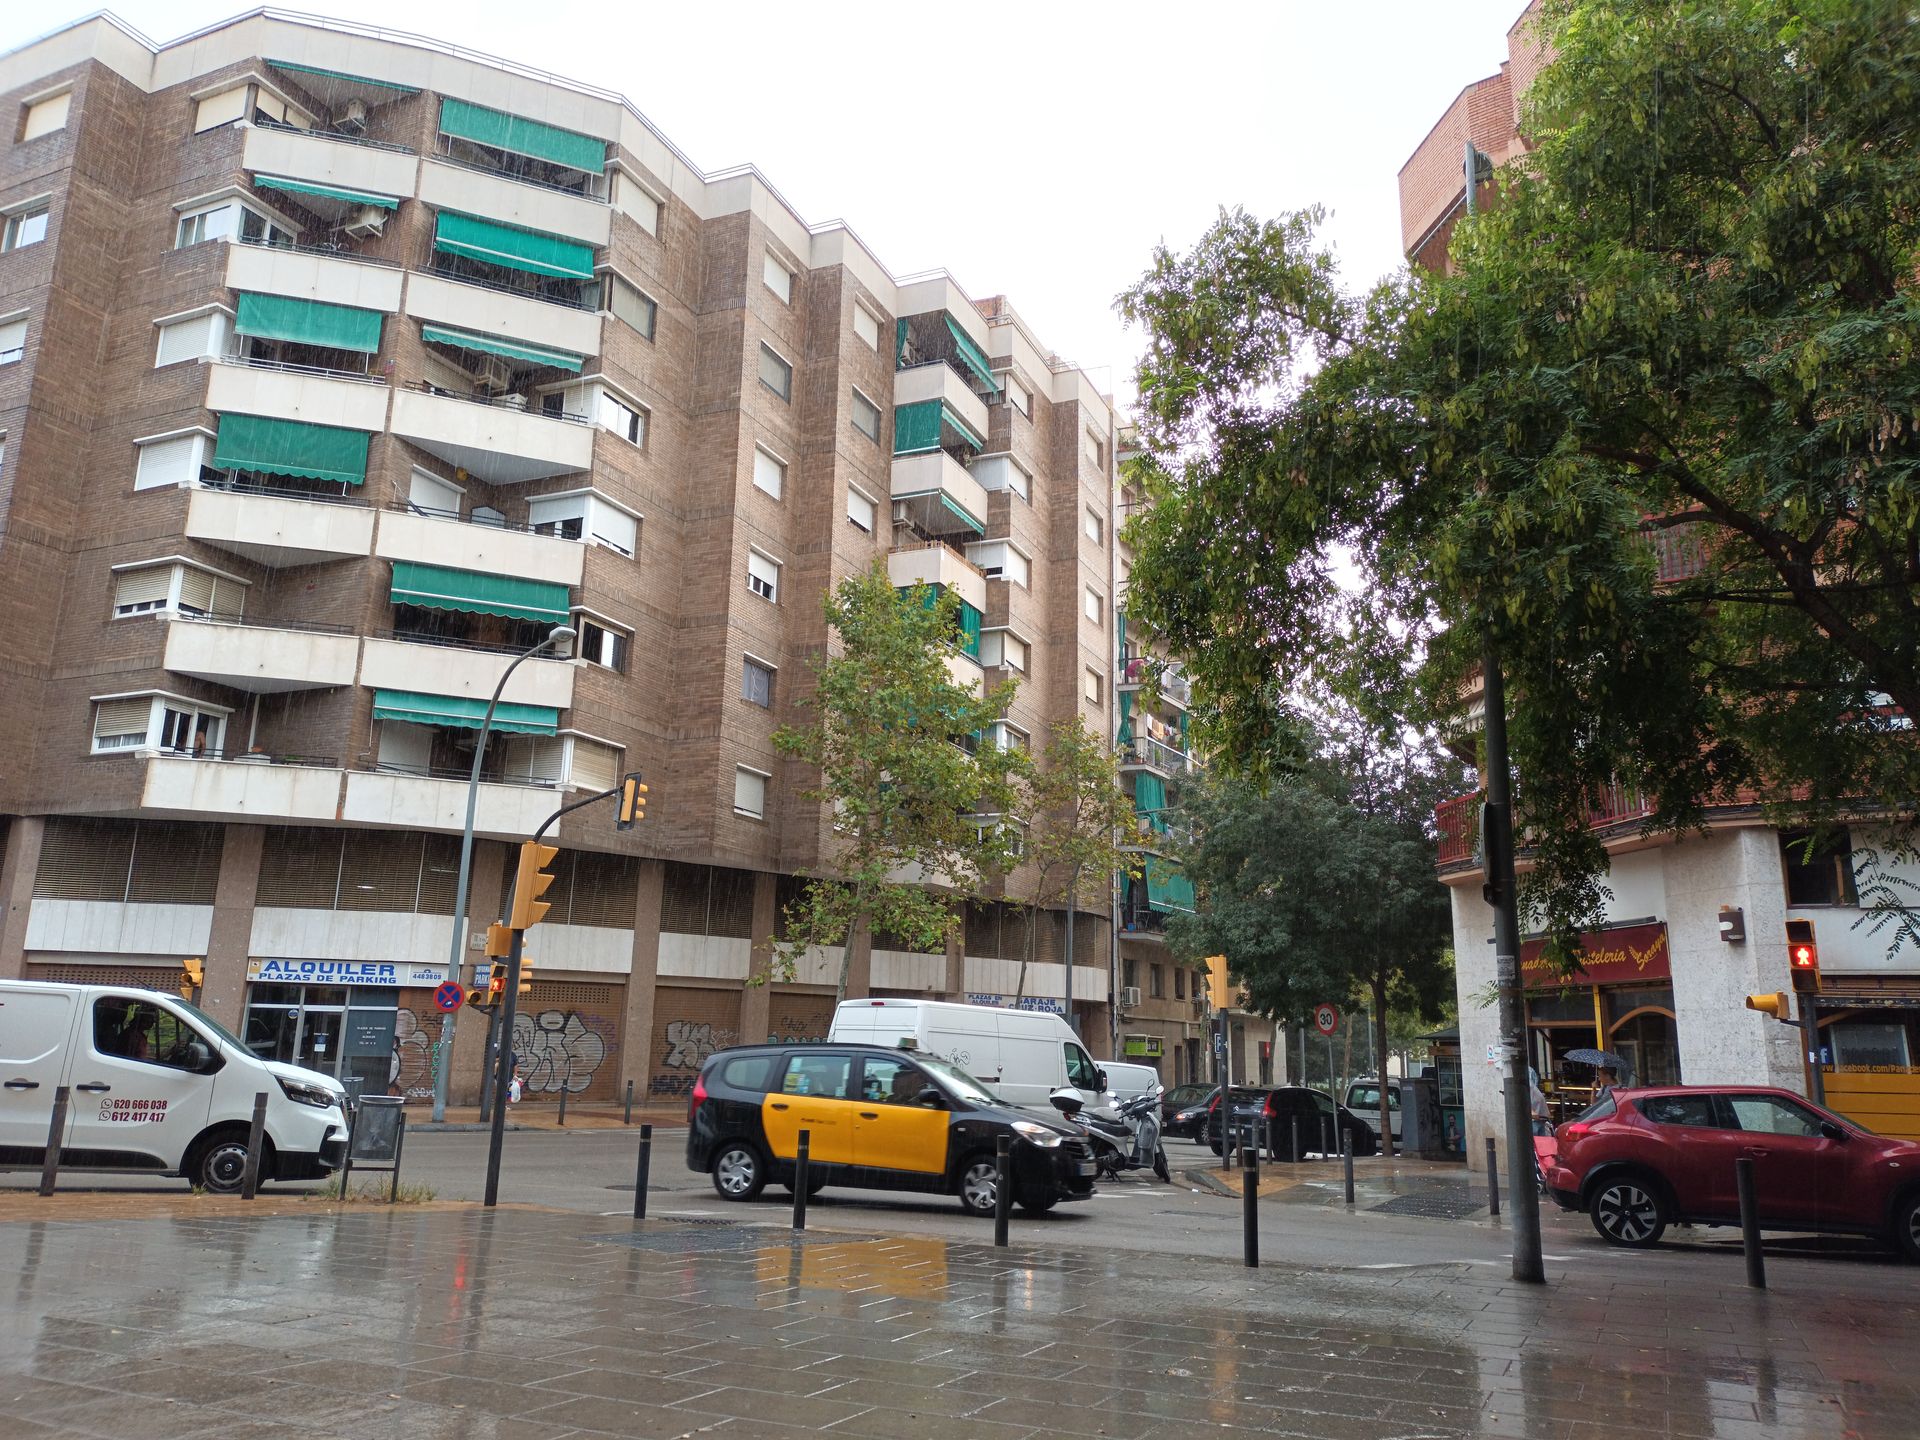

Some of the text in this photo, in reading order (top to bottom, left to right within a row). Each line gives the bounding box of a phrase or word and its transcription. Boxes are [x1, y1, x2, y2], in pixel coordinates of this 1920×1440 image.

[264, 960, 396, 976] ALQUILER
[258, 973, 312, 981] PLAZAS
[339, 975, 397, 984] PARKING
[1020, 997, 1056, 1006] ARAJE
[1320, 1013, 1333, 1025] 30
[113, 1099, 168, 1110] 620 666 038
[111, 1111, 166, 1122] 612 417 417
